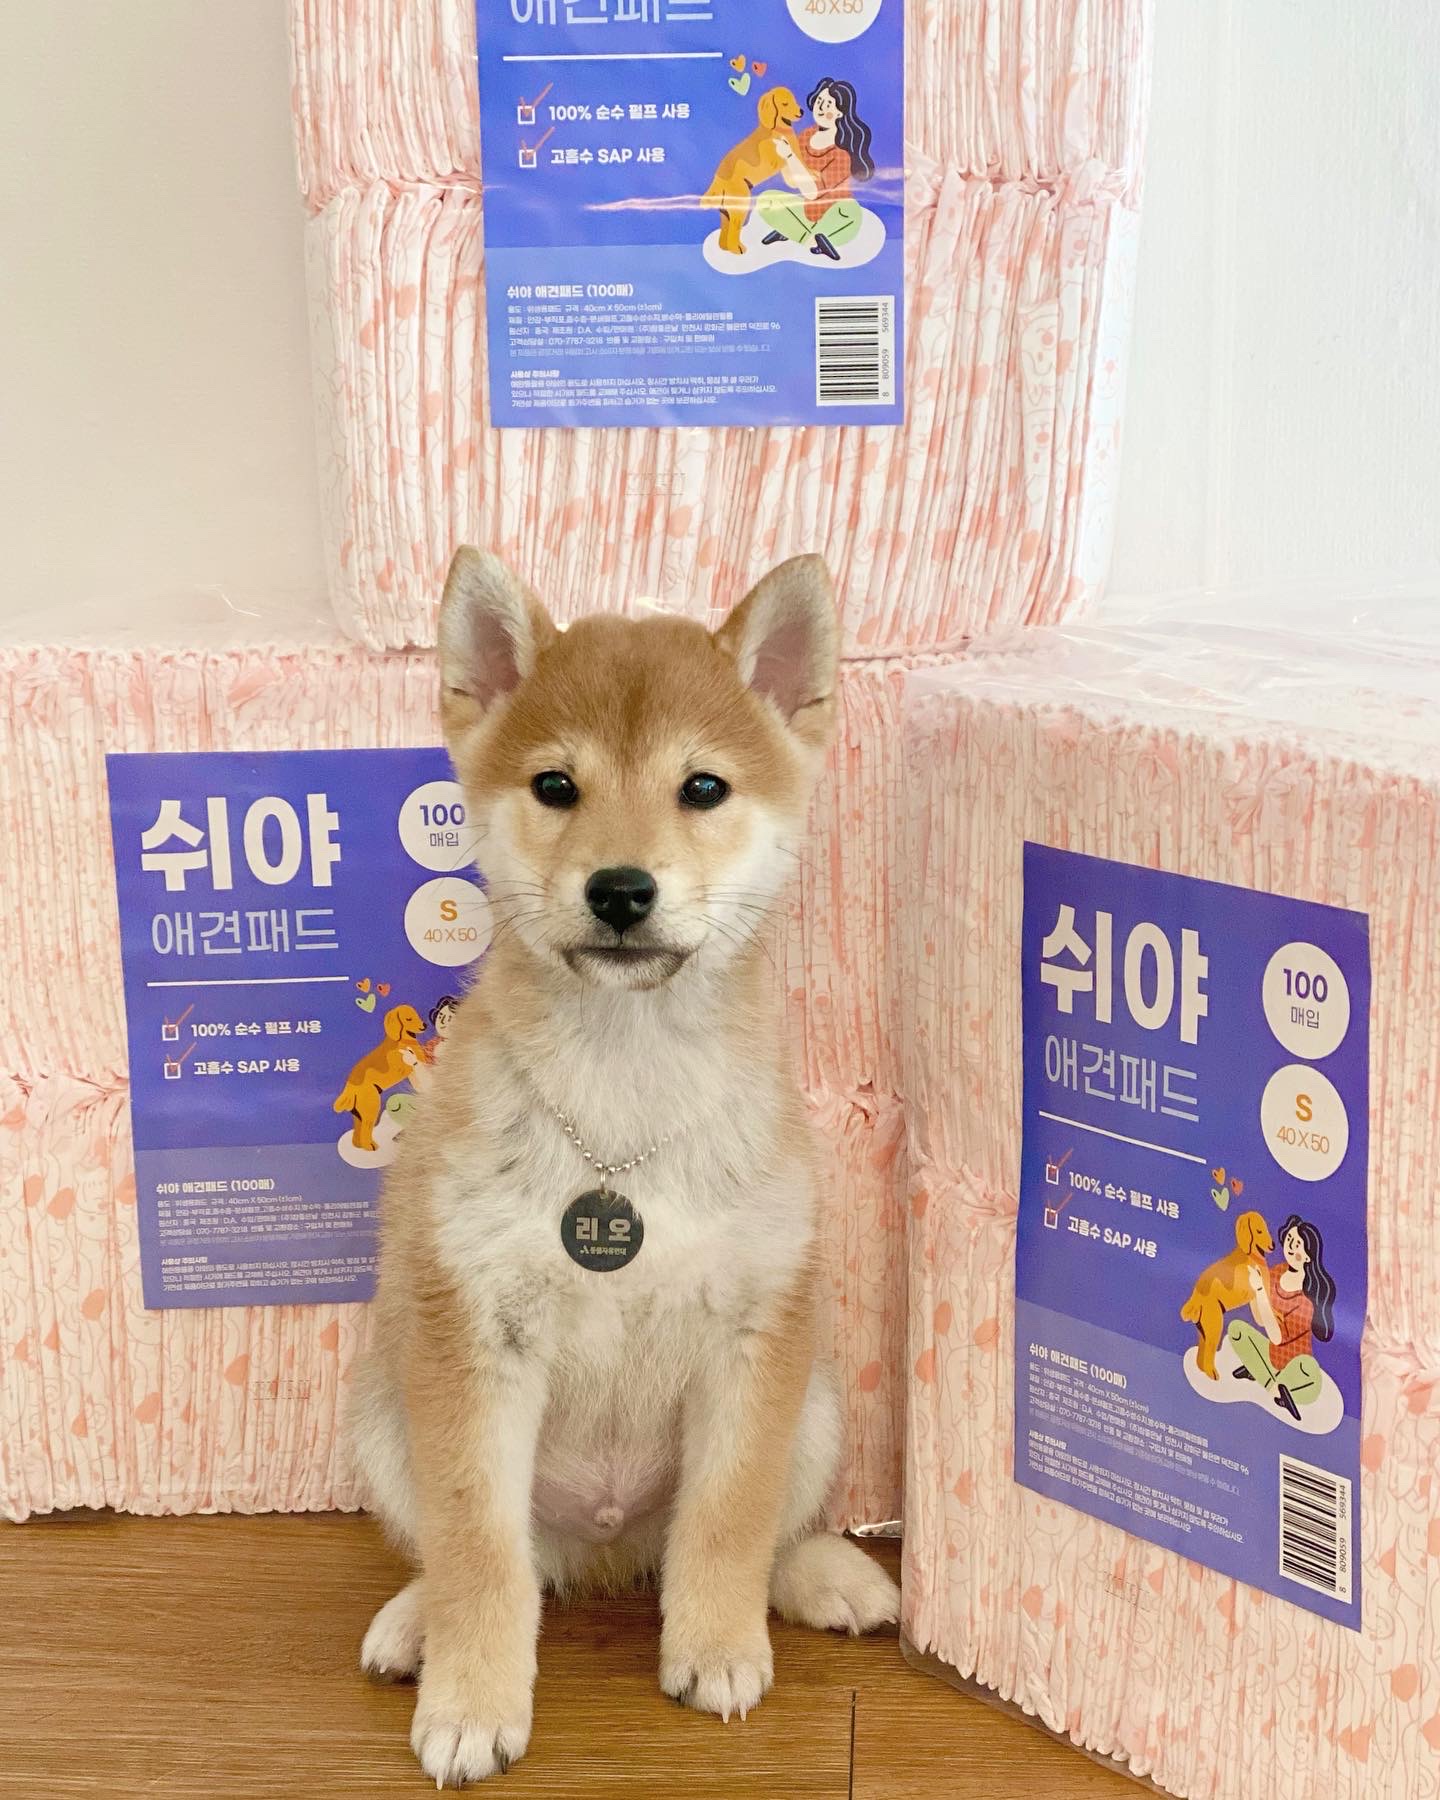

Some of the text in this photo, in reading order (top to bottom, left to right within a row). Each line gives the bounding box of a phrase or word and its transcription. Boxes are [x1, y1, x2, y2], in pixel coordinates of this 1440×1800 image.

[548, 103, 690, 121] 100% 순수 펄프 사용
[551, 148, 665, 164] 고흡수 SAP 사용
[507, 283, 634, 298] 쉬야 애견패드 (100매)
[881, 302, 889, 333] 569344
[881, 348, 889, 379] 809059
[419, 803, 466, 827] 100
[141, 793, 341, 891] 쉬야
[429, 831, 460, 847] 매입
[439, 899, 458, 922] S
[152, 908, 339, 956] 애견패드
[1040, 904, 1209, 1045] 쉬야
[1282, 968, 1328, 1004] 100
[191, 1020, 322, 1038] 100% 순수 펄프 사용
[1290, 1005, 1320, 1030] 매입
[193, 1058, 300, 1076] 고흡수 SAP 사용
[1045, 1034, 1199, 1122] 애견패드
[1295, 1093, 1313, 1122] S
[156, 1179, 275, 1195] 쉬야 애견패드 (100매)
[1068, 1171, 1180, 1219] 100% 순수 펄프 사용
[1067, 1216, 1158, 1258] 고흡수 SAP 사용
[1029, 1342, 1048, 1361] 쉬야
[1050, 1349, 1088, 1373] 애견패드
[1090, 1364, 1127, 1389] (100매)
[1339, 1537, 1347, 1574] 809059
